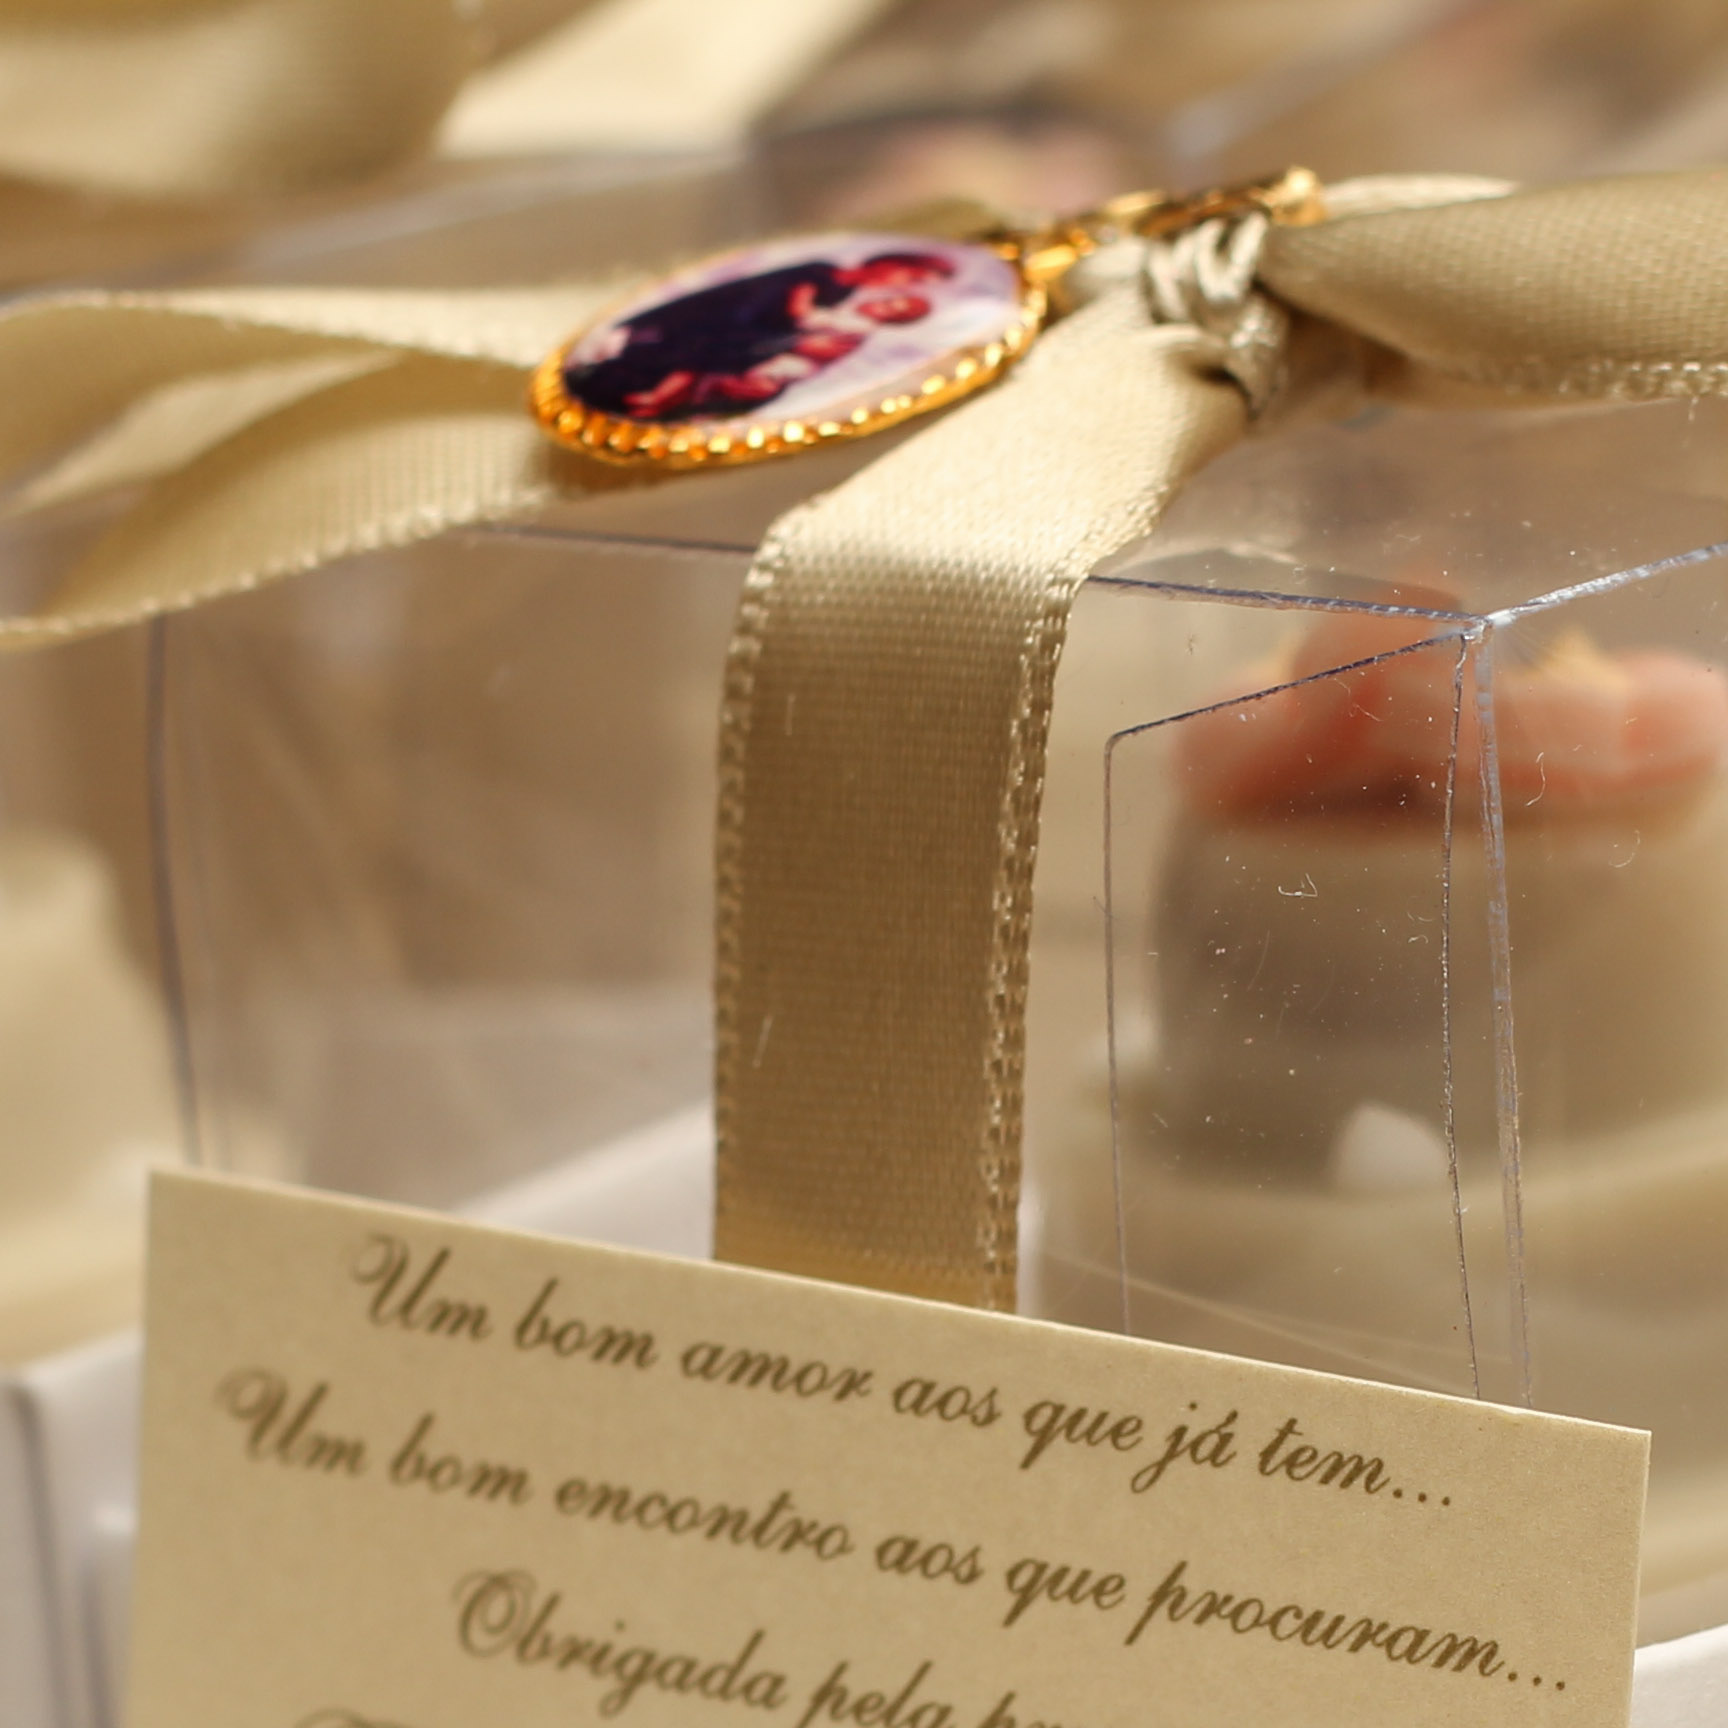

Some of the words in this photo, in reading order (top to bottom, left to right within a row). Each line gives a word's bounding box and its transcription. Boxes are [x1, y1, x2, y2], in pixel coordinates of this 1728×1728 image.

[349, 1232, 495, 1341] Um
[515, 1274, 660, 1372] bom
[680, 1328, 876, 1405] amor
[892, 1372, 1003, 1430] aos
[1021, 1395, 1144, 1468] que
[1132, 1403, 1239, 1495] já
[1255, 1412, 1454, 1508] tem...
[214, 1367, 368, 1475] Um
[390, 1414, 532, 1508] bom
[555, 1467, 856, 1560] encontro
[875, 1521, 985, 1586] aos
[1000, 1552, 1126, 1627] que
[1126, 1560, 1570, 1691] procuram...
[451, 1566, 789, 1717] Obrigada
